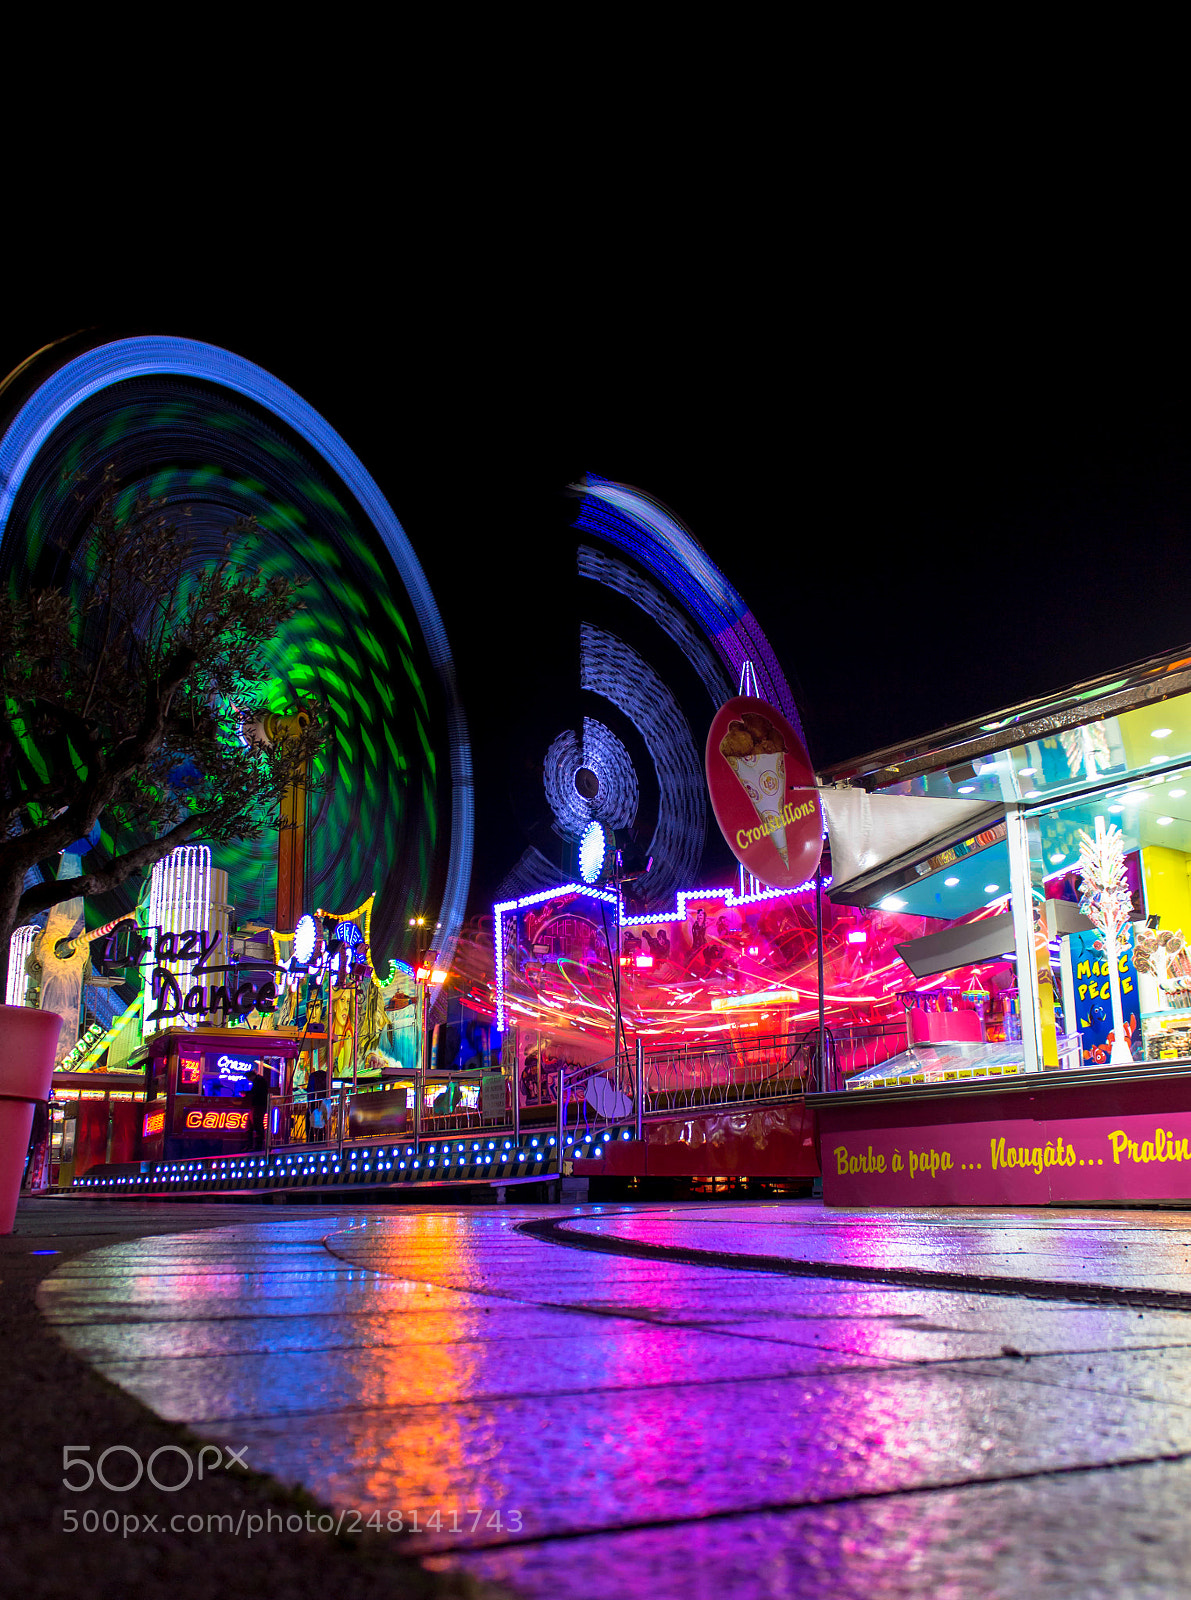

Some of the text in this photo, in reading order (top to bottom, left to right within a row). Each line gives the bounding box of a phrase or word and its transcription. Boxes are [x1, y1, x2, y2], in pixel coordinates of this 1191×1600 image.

[736, 800, 815, 849] Croustillons
[102, 918, 288, 977] Crazy
[1077, 954, 1129, 980] MAGC
[145, 967, 279, 1021] Dance
[1078, 977, 1134, 1001] PÊCE
[834, 1145, 887, 1175] Barbe
[891, 1149, 904, 1173] à
[909, 1149, 954, 1179] papa
